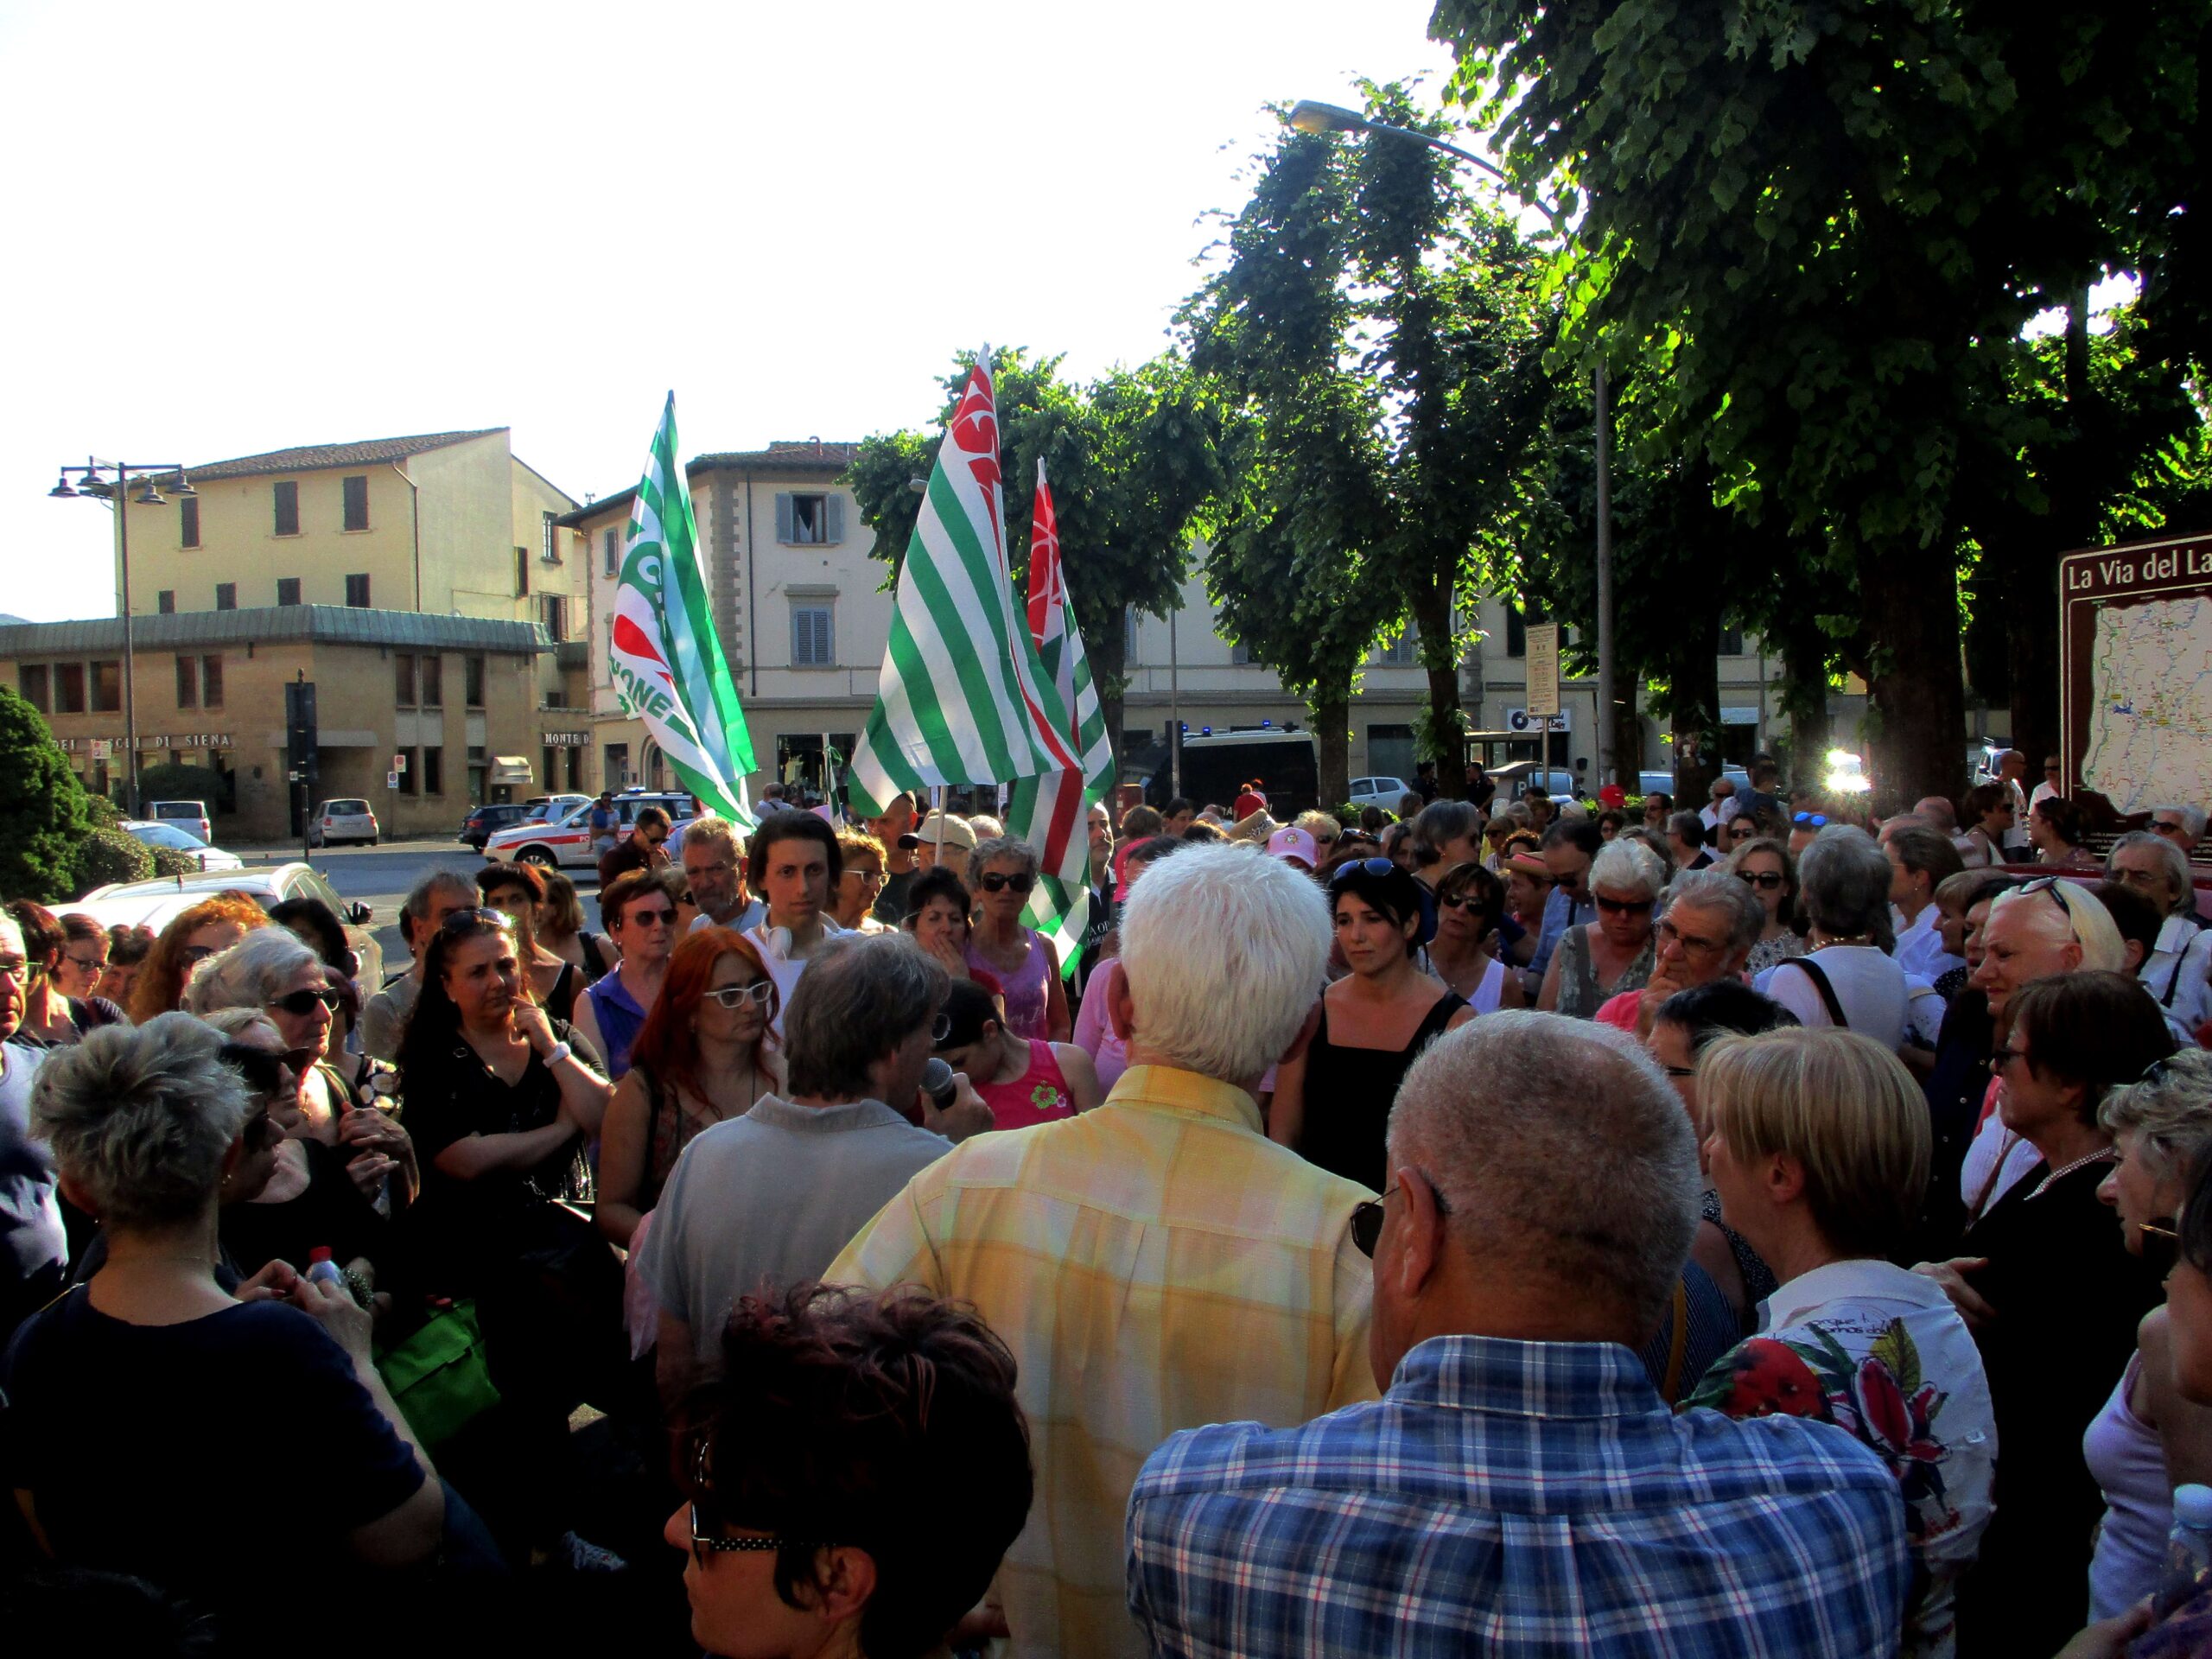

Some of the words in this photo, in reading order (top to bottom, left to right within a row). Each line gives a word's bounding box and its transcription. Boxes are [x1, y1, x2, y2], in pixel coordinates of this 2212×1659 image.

[2069, 566, 2092, 590] La
[2099, 559, 2134, 586] Via
[2142, 550, 2178, 581] del
[52, 739, 75, 750] DEI
[156, 736, 170, 747] DI
[185, 734, 230, 747] SIENA
[545, 733, 579, 744] MONTE
[1517, 781, 1528, 796] P
